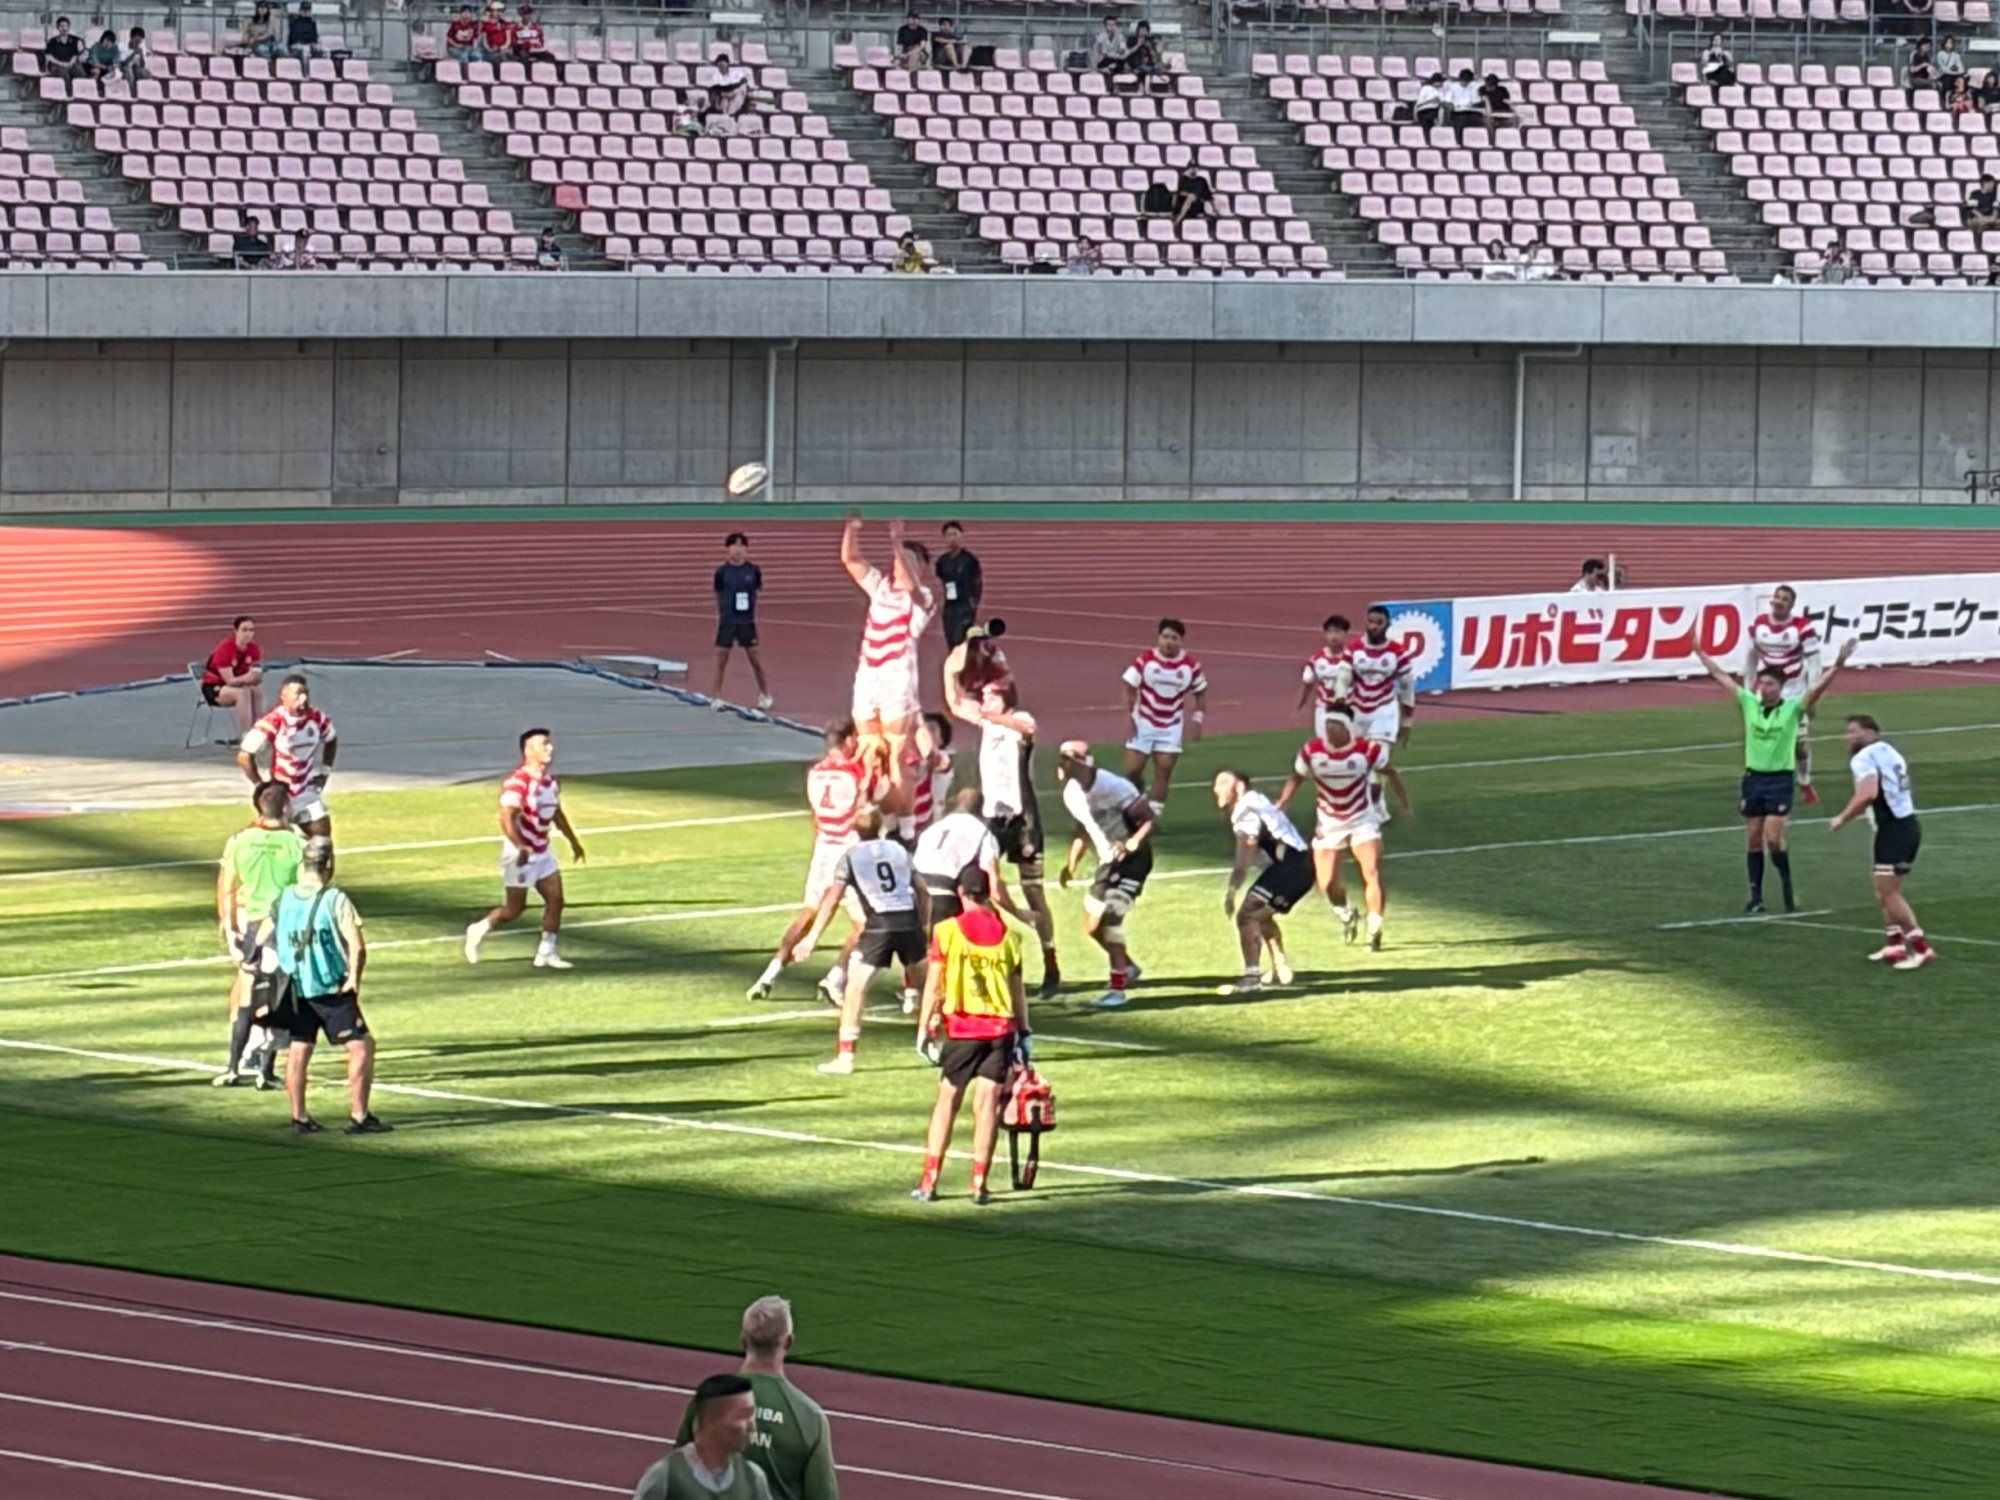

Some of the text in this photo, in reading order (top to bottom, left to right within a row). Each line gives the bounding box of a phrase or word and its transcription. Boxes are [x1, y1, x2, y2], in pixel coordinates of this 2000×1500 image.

[1460, 602, 1740, 671] リポビタンD
[877, 861, 896, 893] 9
